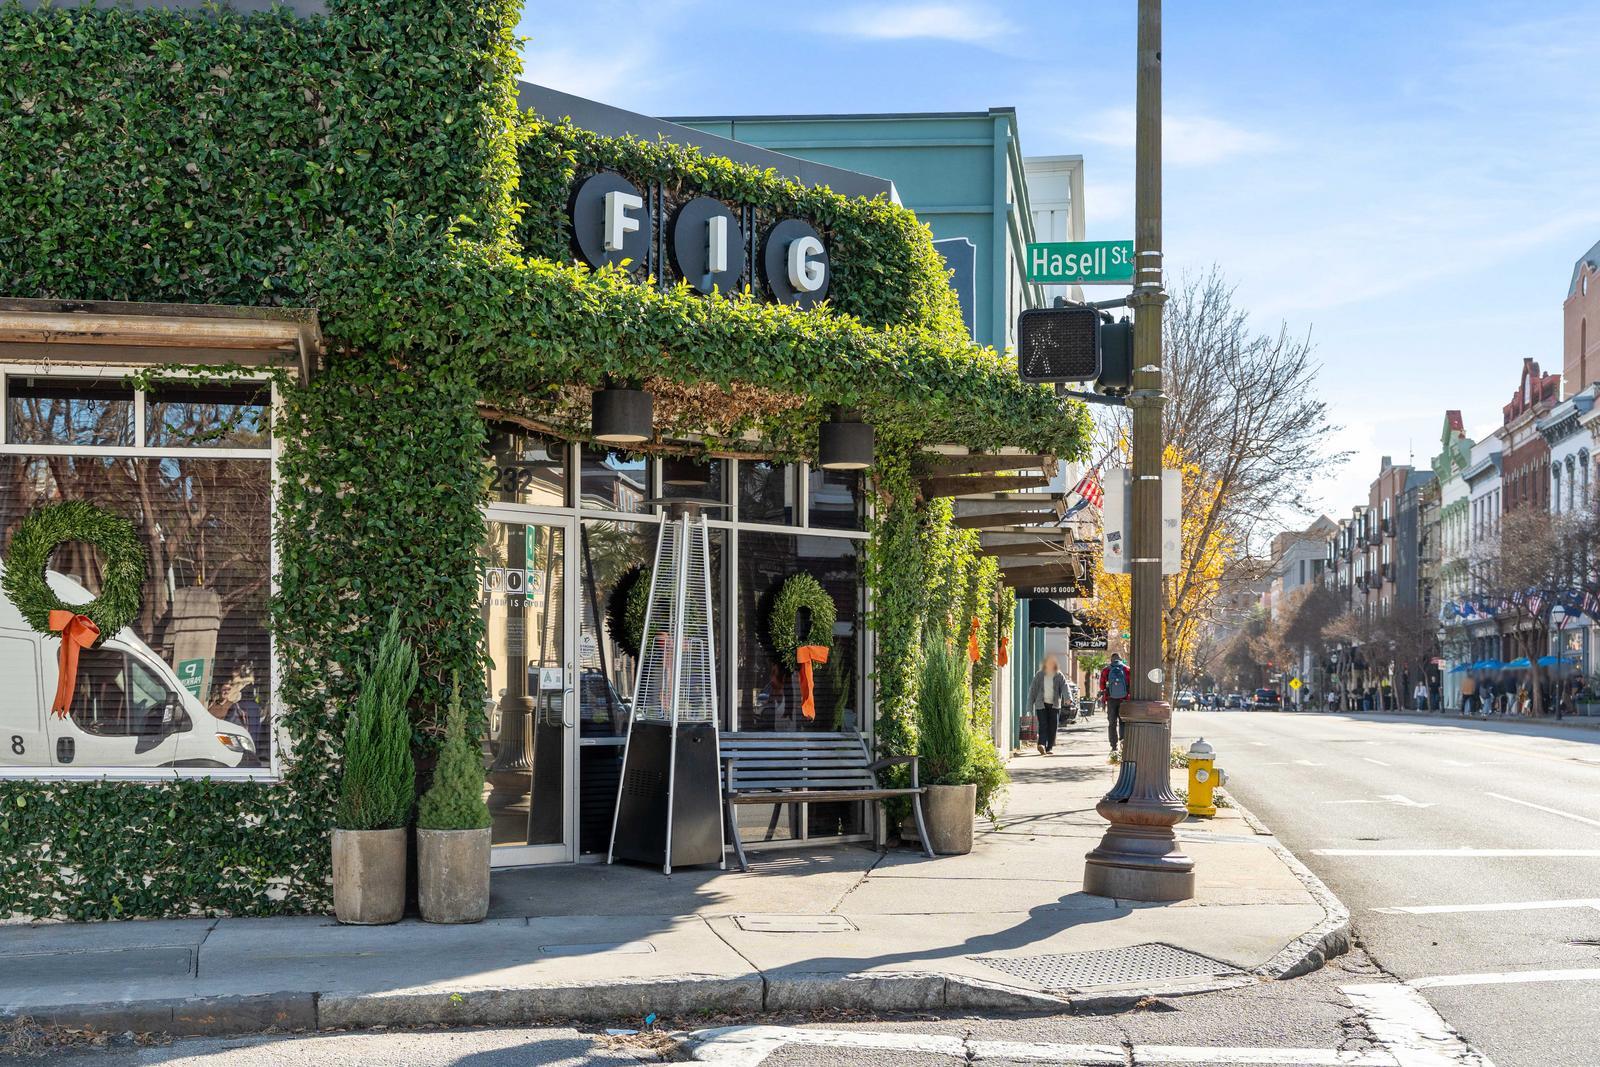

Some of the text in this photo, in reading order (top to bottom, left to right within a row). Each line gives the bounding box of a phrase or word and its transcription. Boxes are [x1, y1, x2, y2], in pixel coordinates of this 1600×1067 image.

[604, 190, 825, 292] FIG
[1032, 246, 1128, 276] Hasell St
[489, 466, 533, 495] 232
[510, 599, 519, 607] IS
